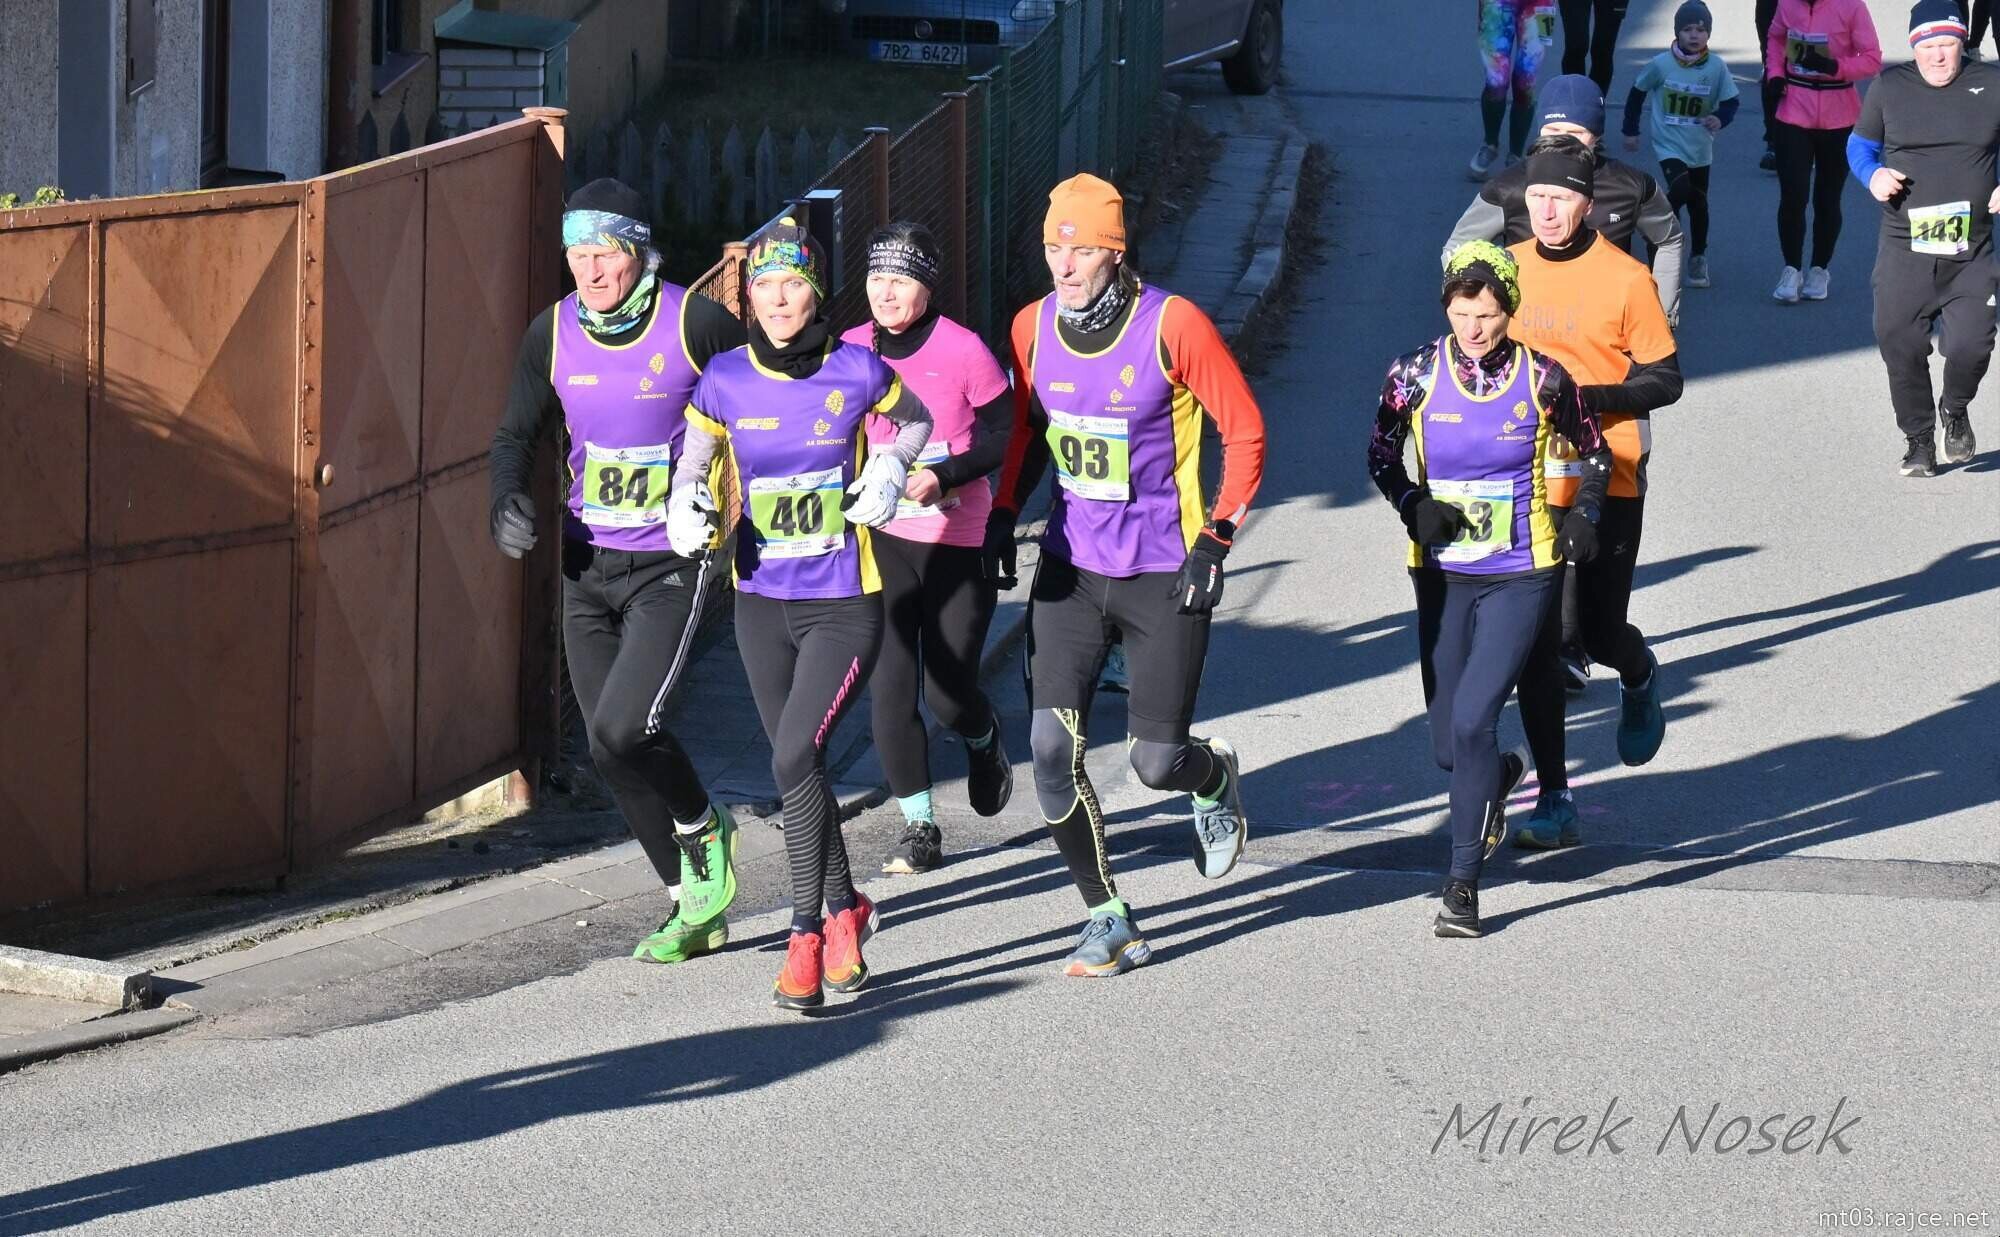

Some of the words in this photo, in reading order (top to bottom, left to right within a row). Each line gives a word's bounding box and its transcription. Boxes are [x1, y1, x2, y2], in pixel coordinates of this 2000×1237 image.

[881, 43, 911, 60] 7B2
[922, 45, 960, 62] 6427
[1668, 93, 1703, 117] 116
[1918, 216, 1963, 242] 143
[817, 438, 847, 446] DRNOVICE
[1060, 435, 1109, 480] 93
[599, 467, 648, 507] 84
[770, 492, 823, 536] 40
[815, 656, 859, 749] DYNAFIT
